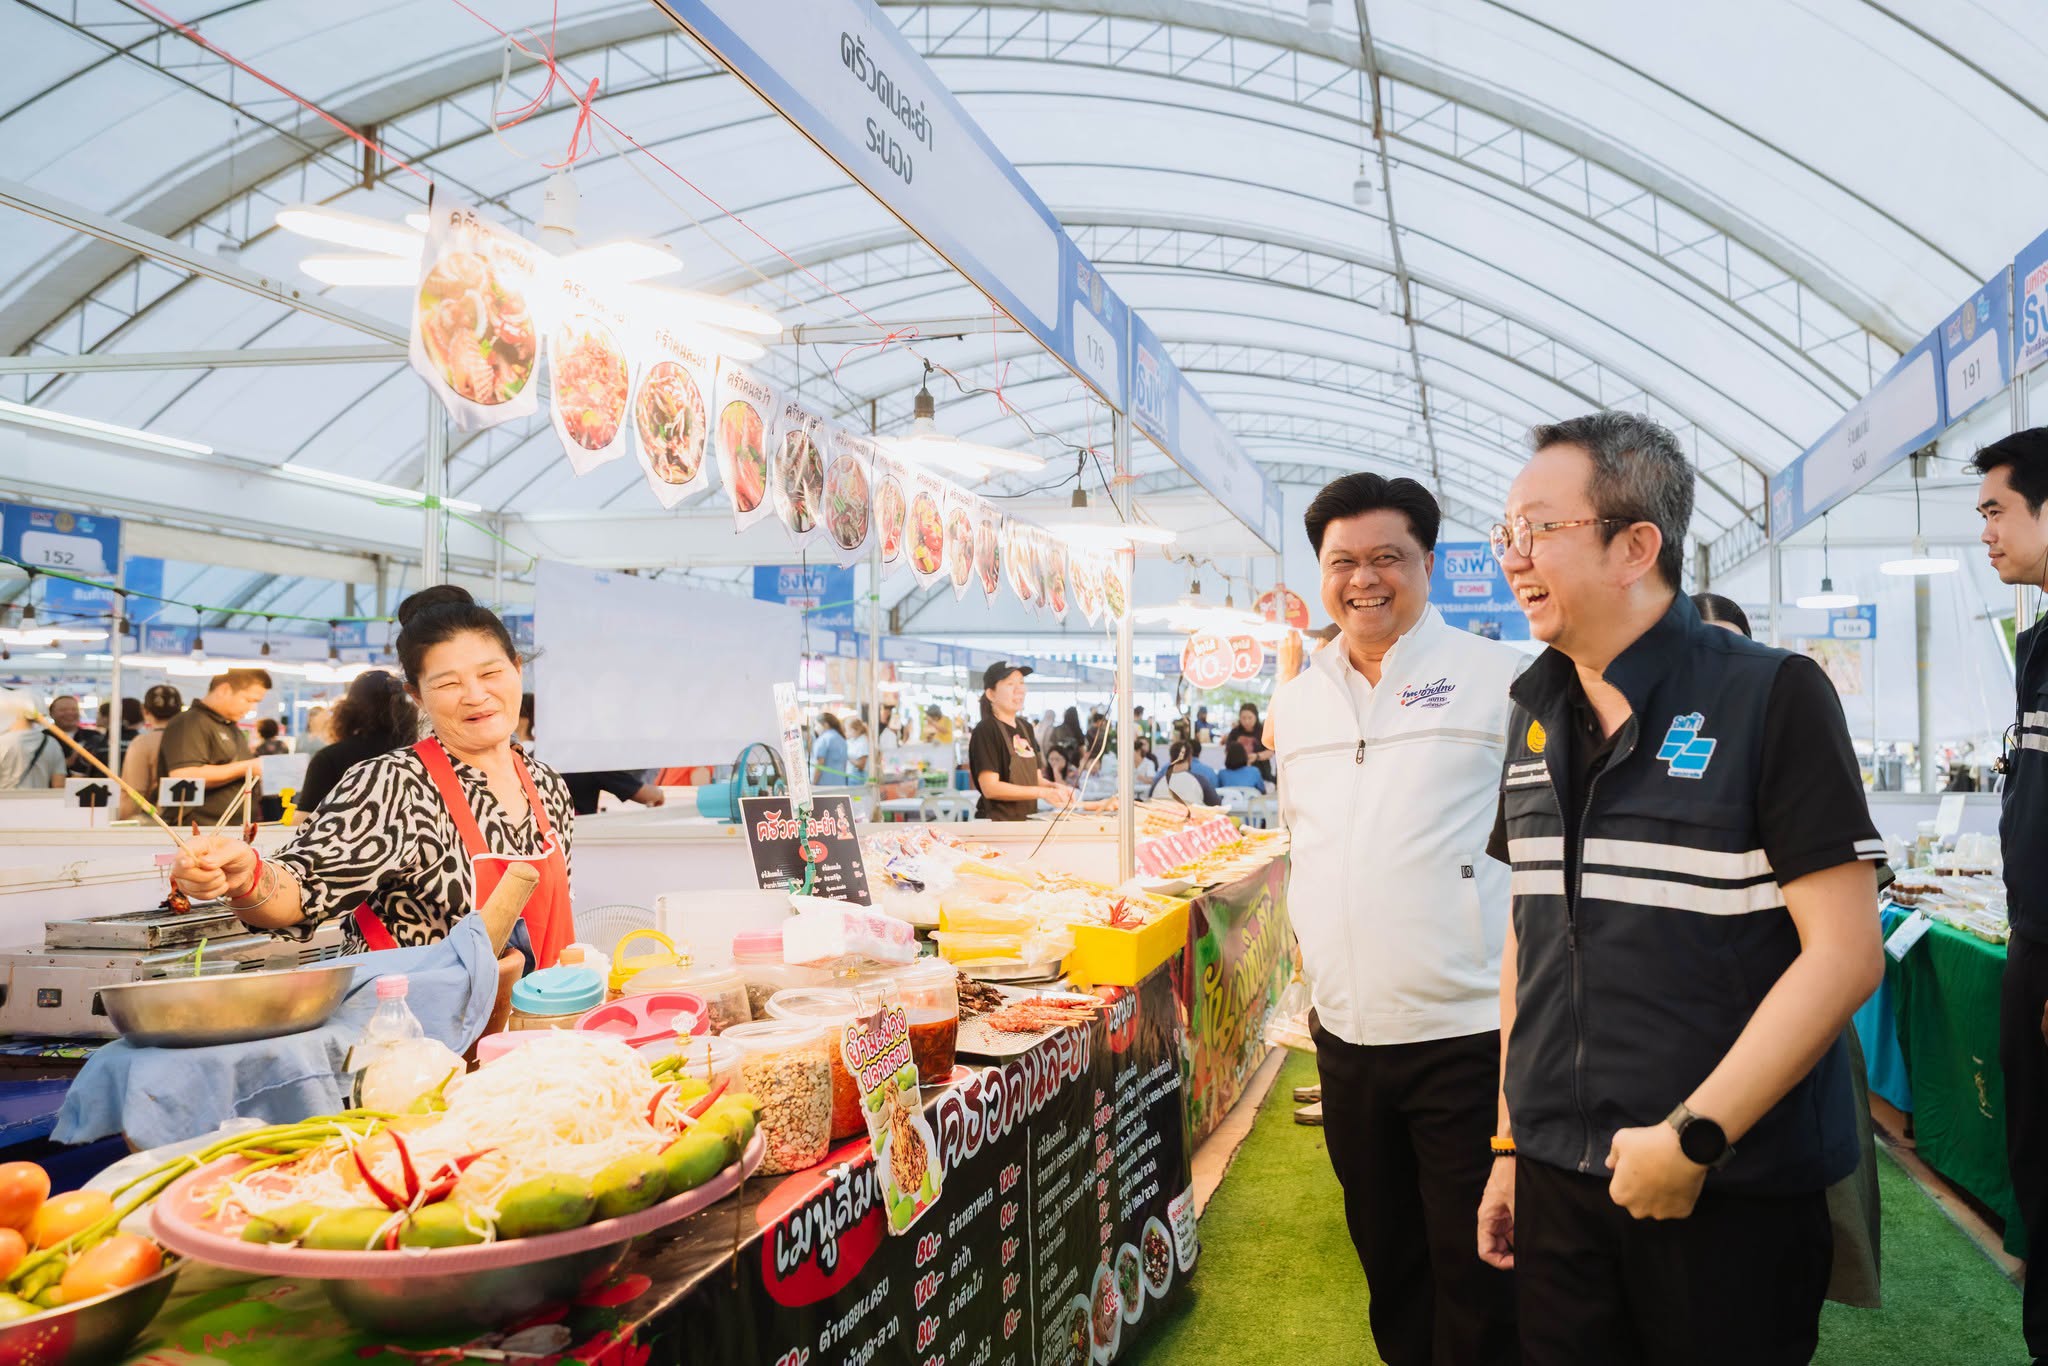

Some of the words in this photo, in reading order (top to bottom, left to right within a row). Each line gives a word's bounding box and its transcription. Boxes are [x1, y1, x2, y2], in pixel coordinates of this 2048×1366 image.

[841, 32, 932, 152] ครัวคนละยำ
[866, 117, 913, 185] ระนอง
[1087, 335, 1105, 370] 179
[1962, 358, 1981, 390] 191
[43, 550, 75, 566] 152
[1235, 652, 1259, 674] 0.-
[861, 1038, 911, 1094] ปลากรอบ
[1000, 1162, 1022, 1196] 120.-
[915, 1231, 942, 1268] 80.-
[950, 1245, 972, 1280] ตำป่า
[1000, 1201, 1019, 1231] 60.-
[819, 1276, 890, 1353] ตำหอยแครง
[914, 1270, 945, 1311] 120.-
[1002, 1236, 1021, 1267] 80.-
[916, 1315, 942, 1354] 80.-
[949, 1330, 966, 1361] ลาบ
[1003, 1272, 1021, 1304] 70.-
[1004, 1308, 1022, 1341] 60.-
